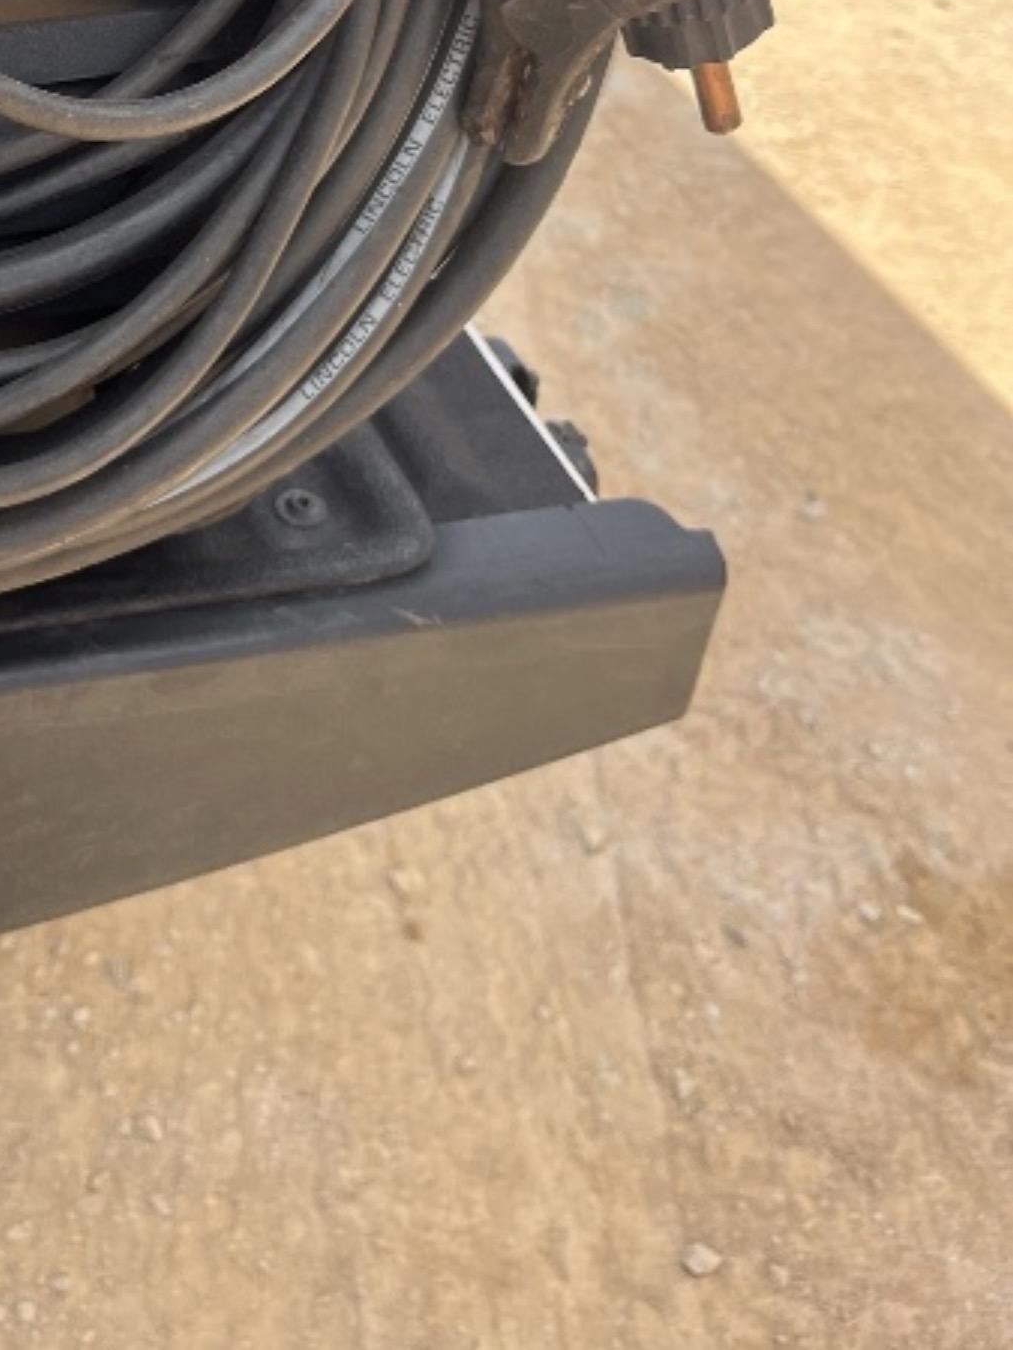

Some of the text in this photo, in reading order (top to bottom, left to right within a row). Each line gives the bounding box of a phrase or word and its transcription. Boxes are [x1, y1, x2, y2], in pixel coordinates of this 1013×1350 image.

[354, 14, 477, 235] LINCOLN ELECTRIC
[302, 199, 445, 399] LINCOLN ELECTRIC
